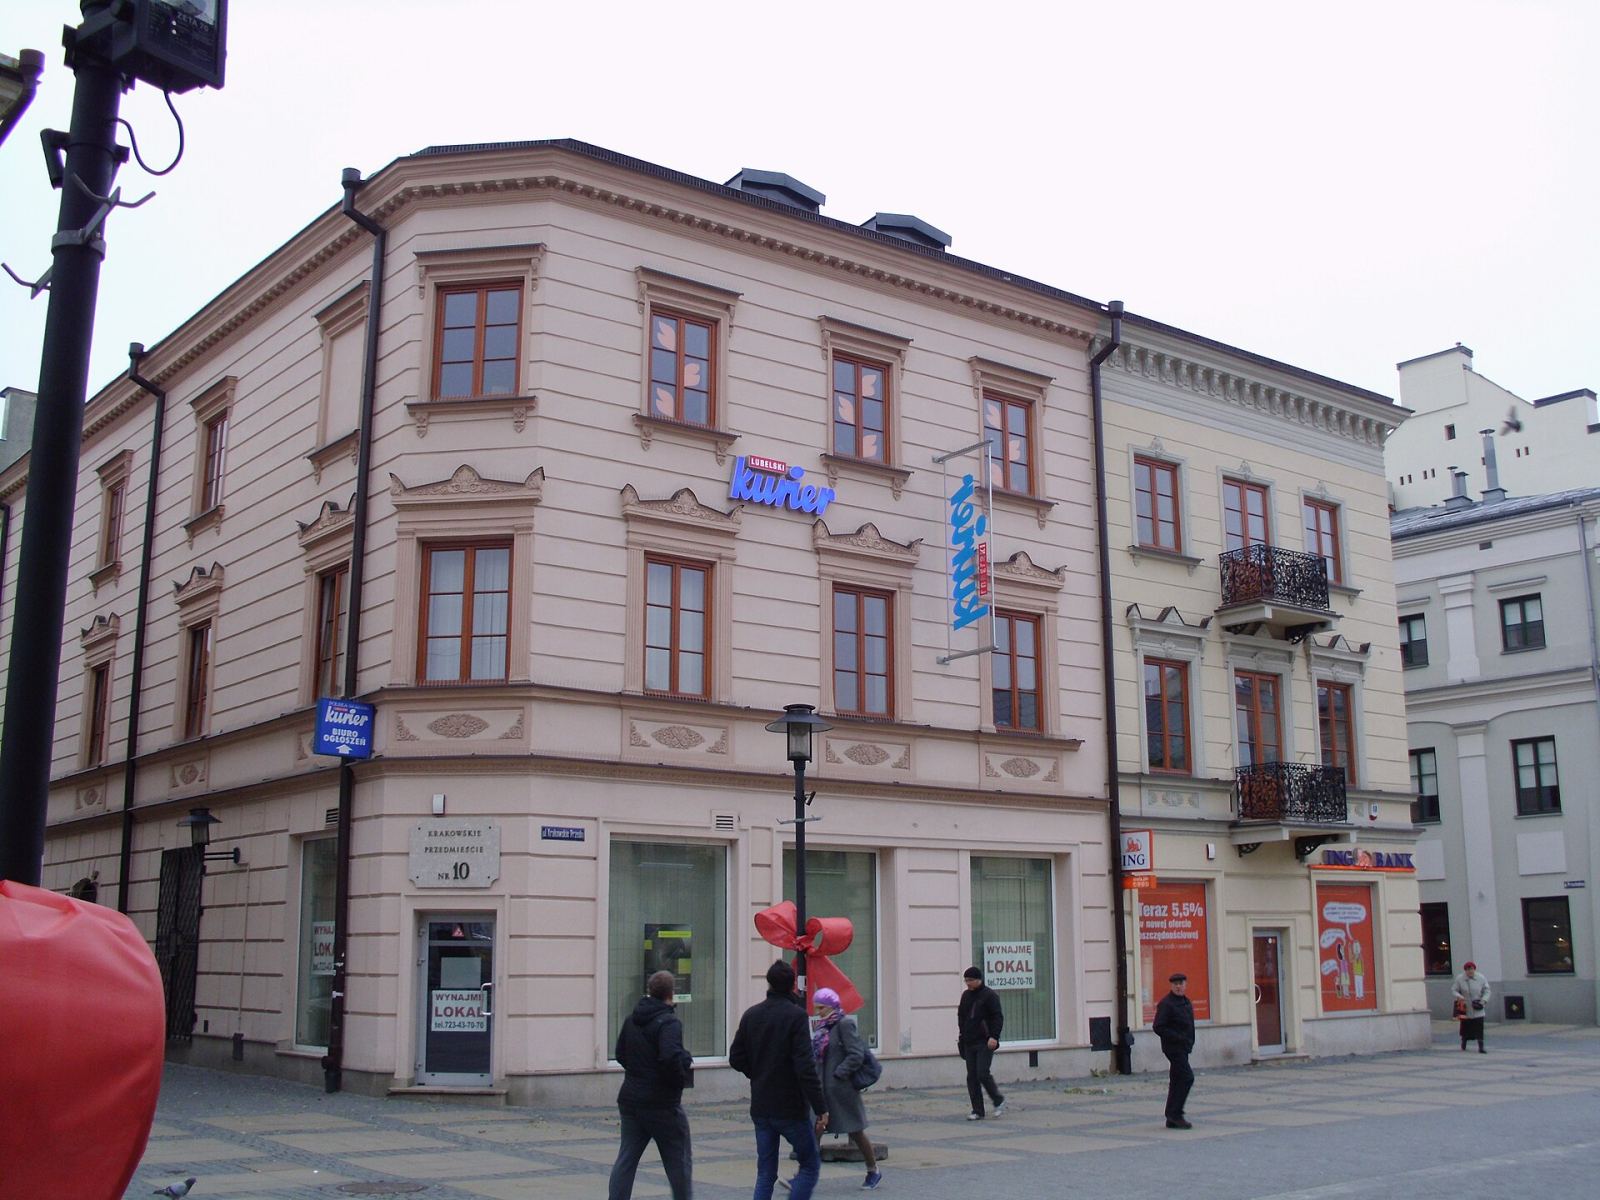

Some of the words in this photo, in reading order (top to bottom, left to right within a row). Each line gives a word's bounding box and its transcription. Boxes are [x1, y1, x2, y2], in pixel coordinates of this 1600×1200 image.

[750, 457, 785, 471] LUBELSKI
[731, 456, 836, 515] kurier
[325, 705, 369, 727] kurier
[332, 728, 359, 738] BIURO
[323, 734, 366, 746] OGŁOSZEŃ
[424, 846, 484, 854] PRZEDMIEŚCIE
[1122, 853, 1145, 867] ING
[1326, 850, 1354, 865] ING
[1374, 851, 1415, 869] BANK
[438, 872, 450, 880] NR
[452, 862, 470, 880] 10
[1138, 902, 1168, 917] Teraz
[1171, 902, 1204, 918] 5,5%
[1146, 919, 1167, 929] nowej
[986, 945, 1031, 956] WYNAJMĘ
[987, 959, 1033, 973] LOKAL
[987, 976, 1033, 987] tel.723-43-70-70
[435, 1006, 485, 1018] LOKAL
[434, 1020, 484, 1029] tel.723-43-70-70
